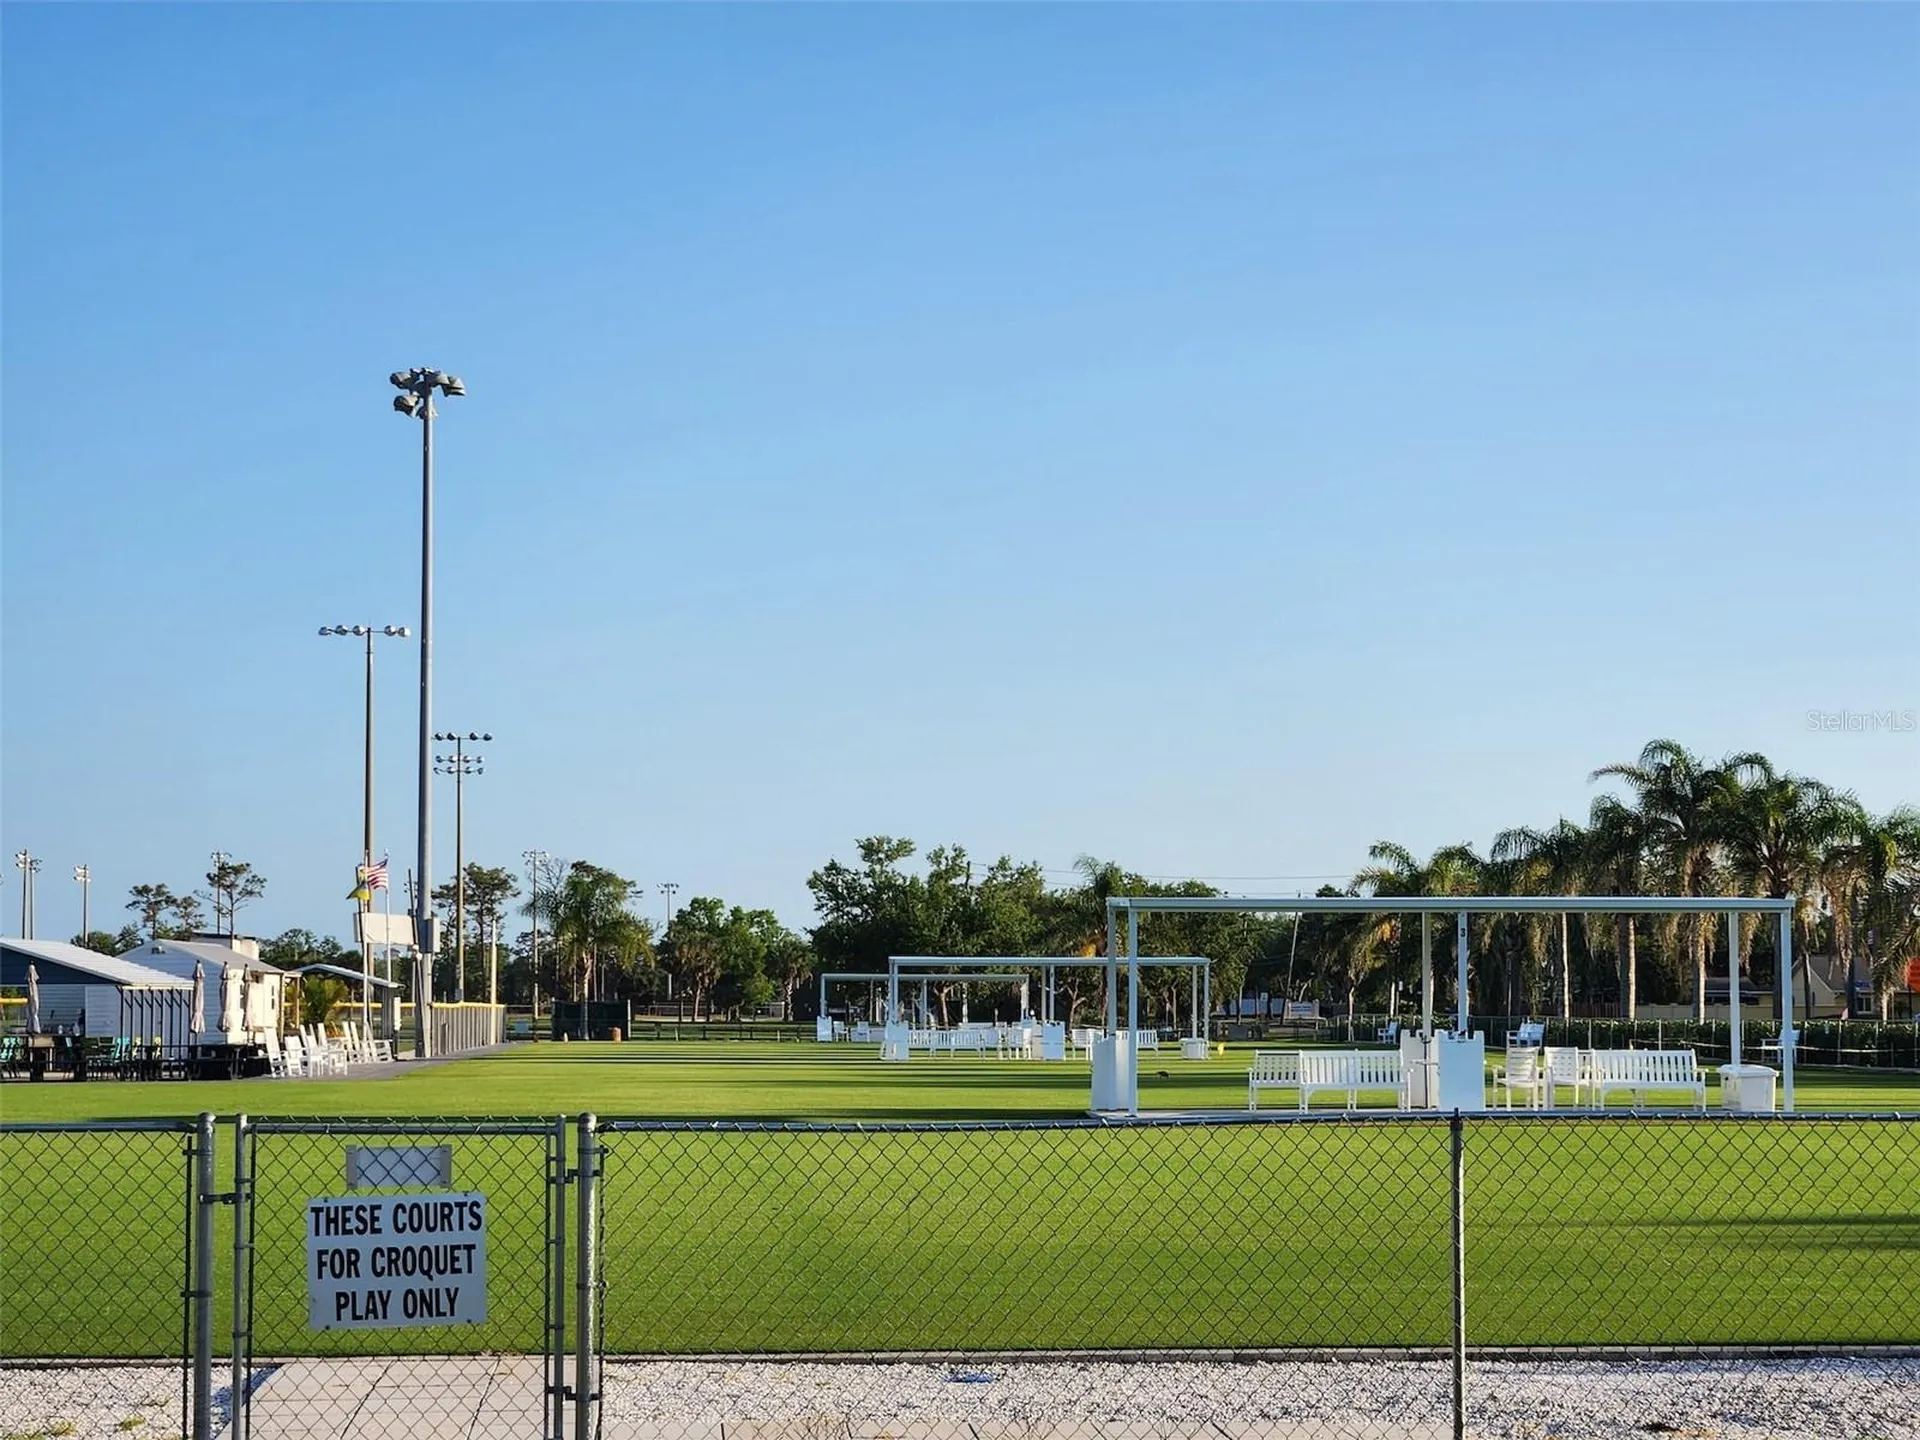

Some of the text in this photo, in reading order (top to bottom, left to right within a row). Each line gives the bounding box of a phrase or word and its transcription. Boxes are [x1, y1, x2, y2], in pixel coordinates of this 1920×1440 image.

[311, 1200, 482, 1237] THESE COURTS
[317, 1243, 476, 1281] FOR CROQUET
[335, 1287, 460, 1321] PLAY ONLY
